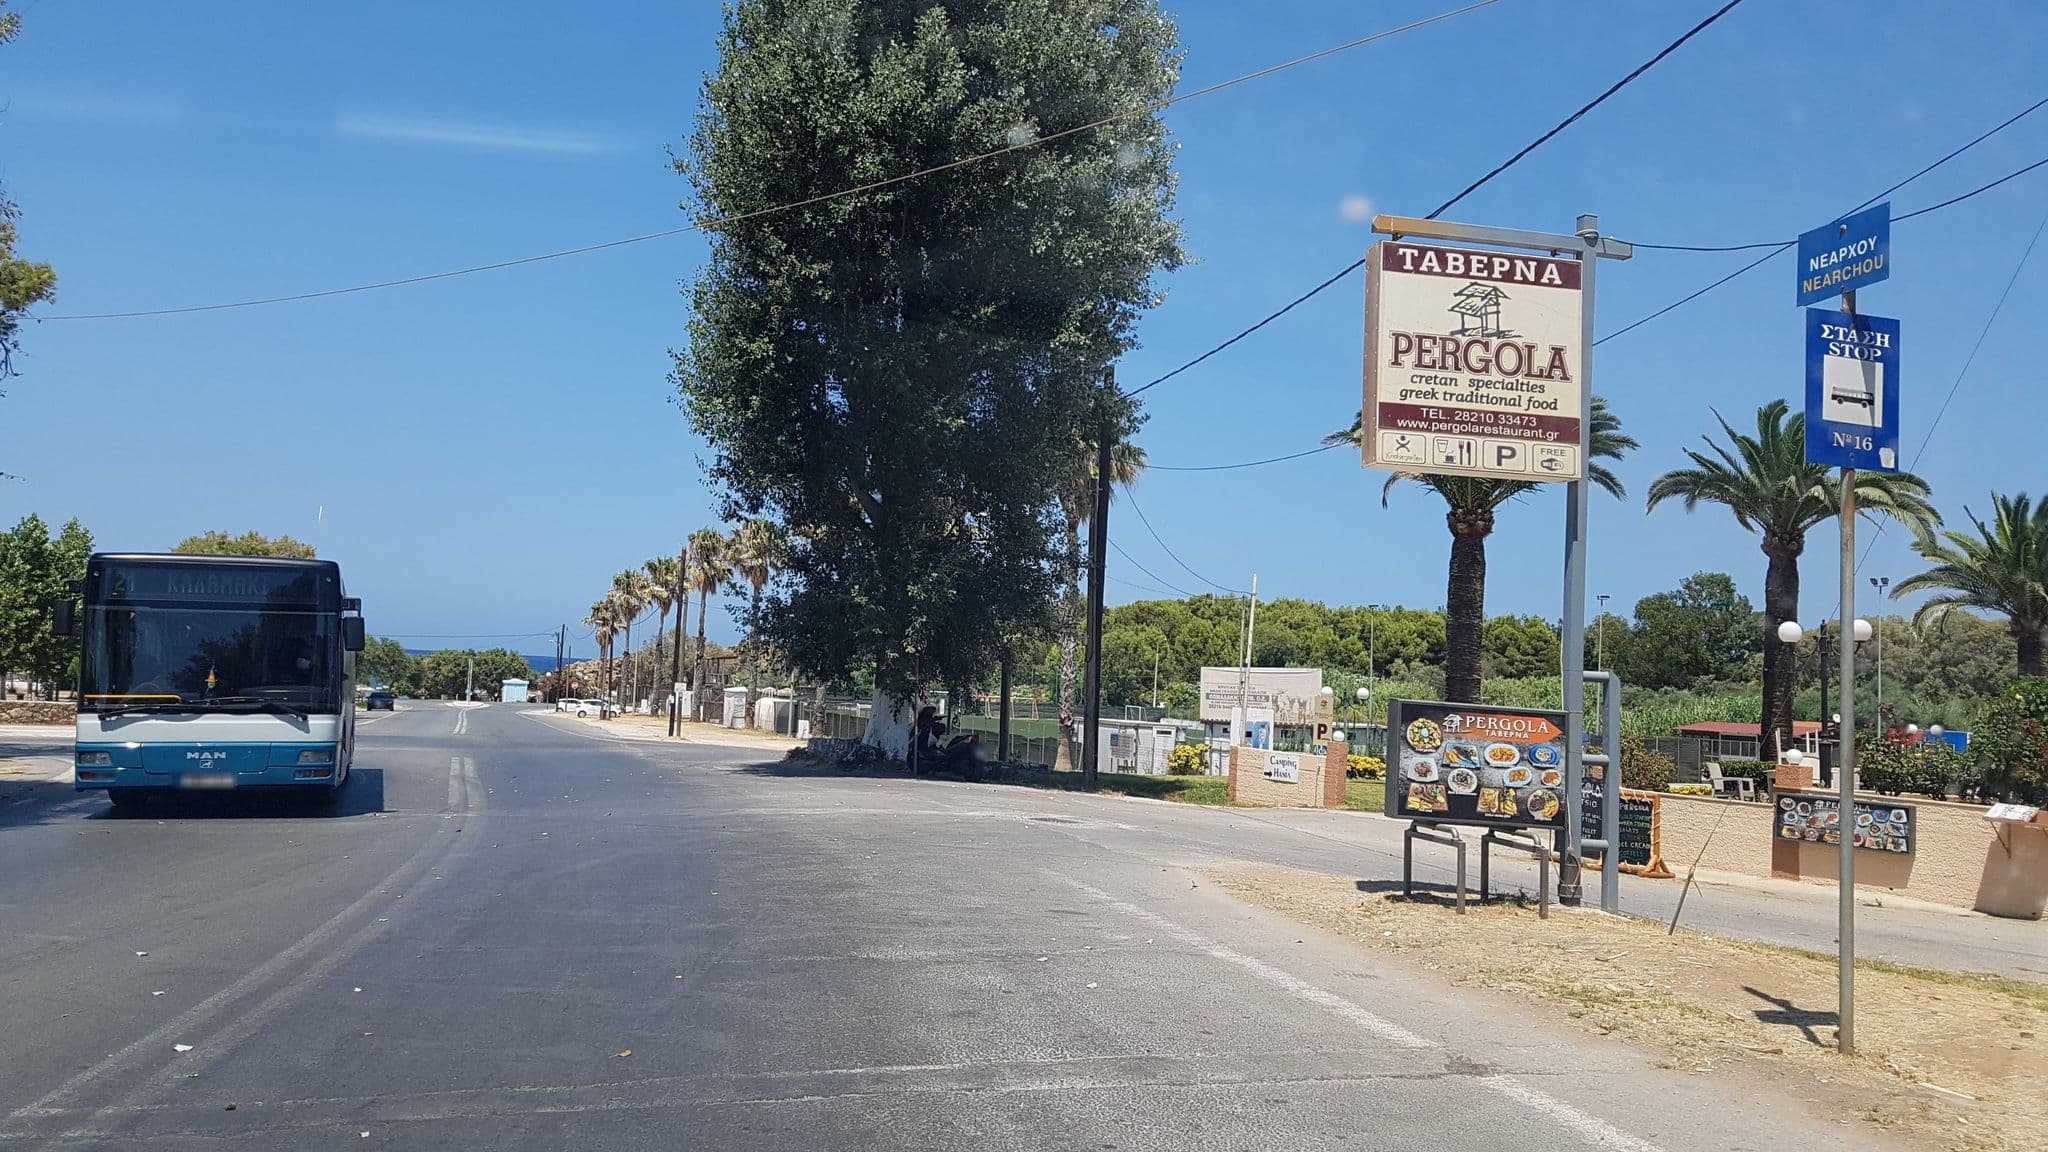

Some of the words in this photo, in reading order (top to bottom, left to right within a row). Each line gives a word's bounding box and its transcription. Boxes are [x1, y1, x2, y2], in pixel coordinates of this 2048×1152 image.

[1809, 235, 1878, 272] ΝΕΑΡΧΟΥ
[1398, 247, 1563, 285] ΤΑΒΕΡΝΑ
[1803, 254, 1884, 293] NEARCHOU
[1820, 324, 1891, 348] ΣΤΑΣΗ
[1389, 330, 1573, 383] PERGOLA
[1828, 341, 1882, 361] STOP
[1410, 373, 1458, 387] cretan
[1468, 376, 1546, 393] specialties
[1399, 388, 1440, 402] greek
[1442, 389, 1522, 408] traditional
[1525, 395, 1558, 411] food
[1420, 408, 1450, 420] TEL.
[1454, 410, 1494, 423] 28210
[1498, 413, 1537, 427] 33473
[1397, 418, 1560, 441] www.pergolarestaurant.gr
[1496, 445, 1517, 466] P
[1540, 448, 1567, 456] FREE
[1317, 723, 1328, 740] P
[1466, 716, 1549, 734] PERGOLA
[1485, 730, 1529, 739] ΤΑΒΕΡΝΑ
[186, 751, 227, 760] MAN
